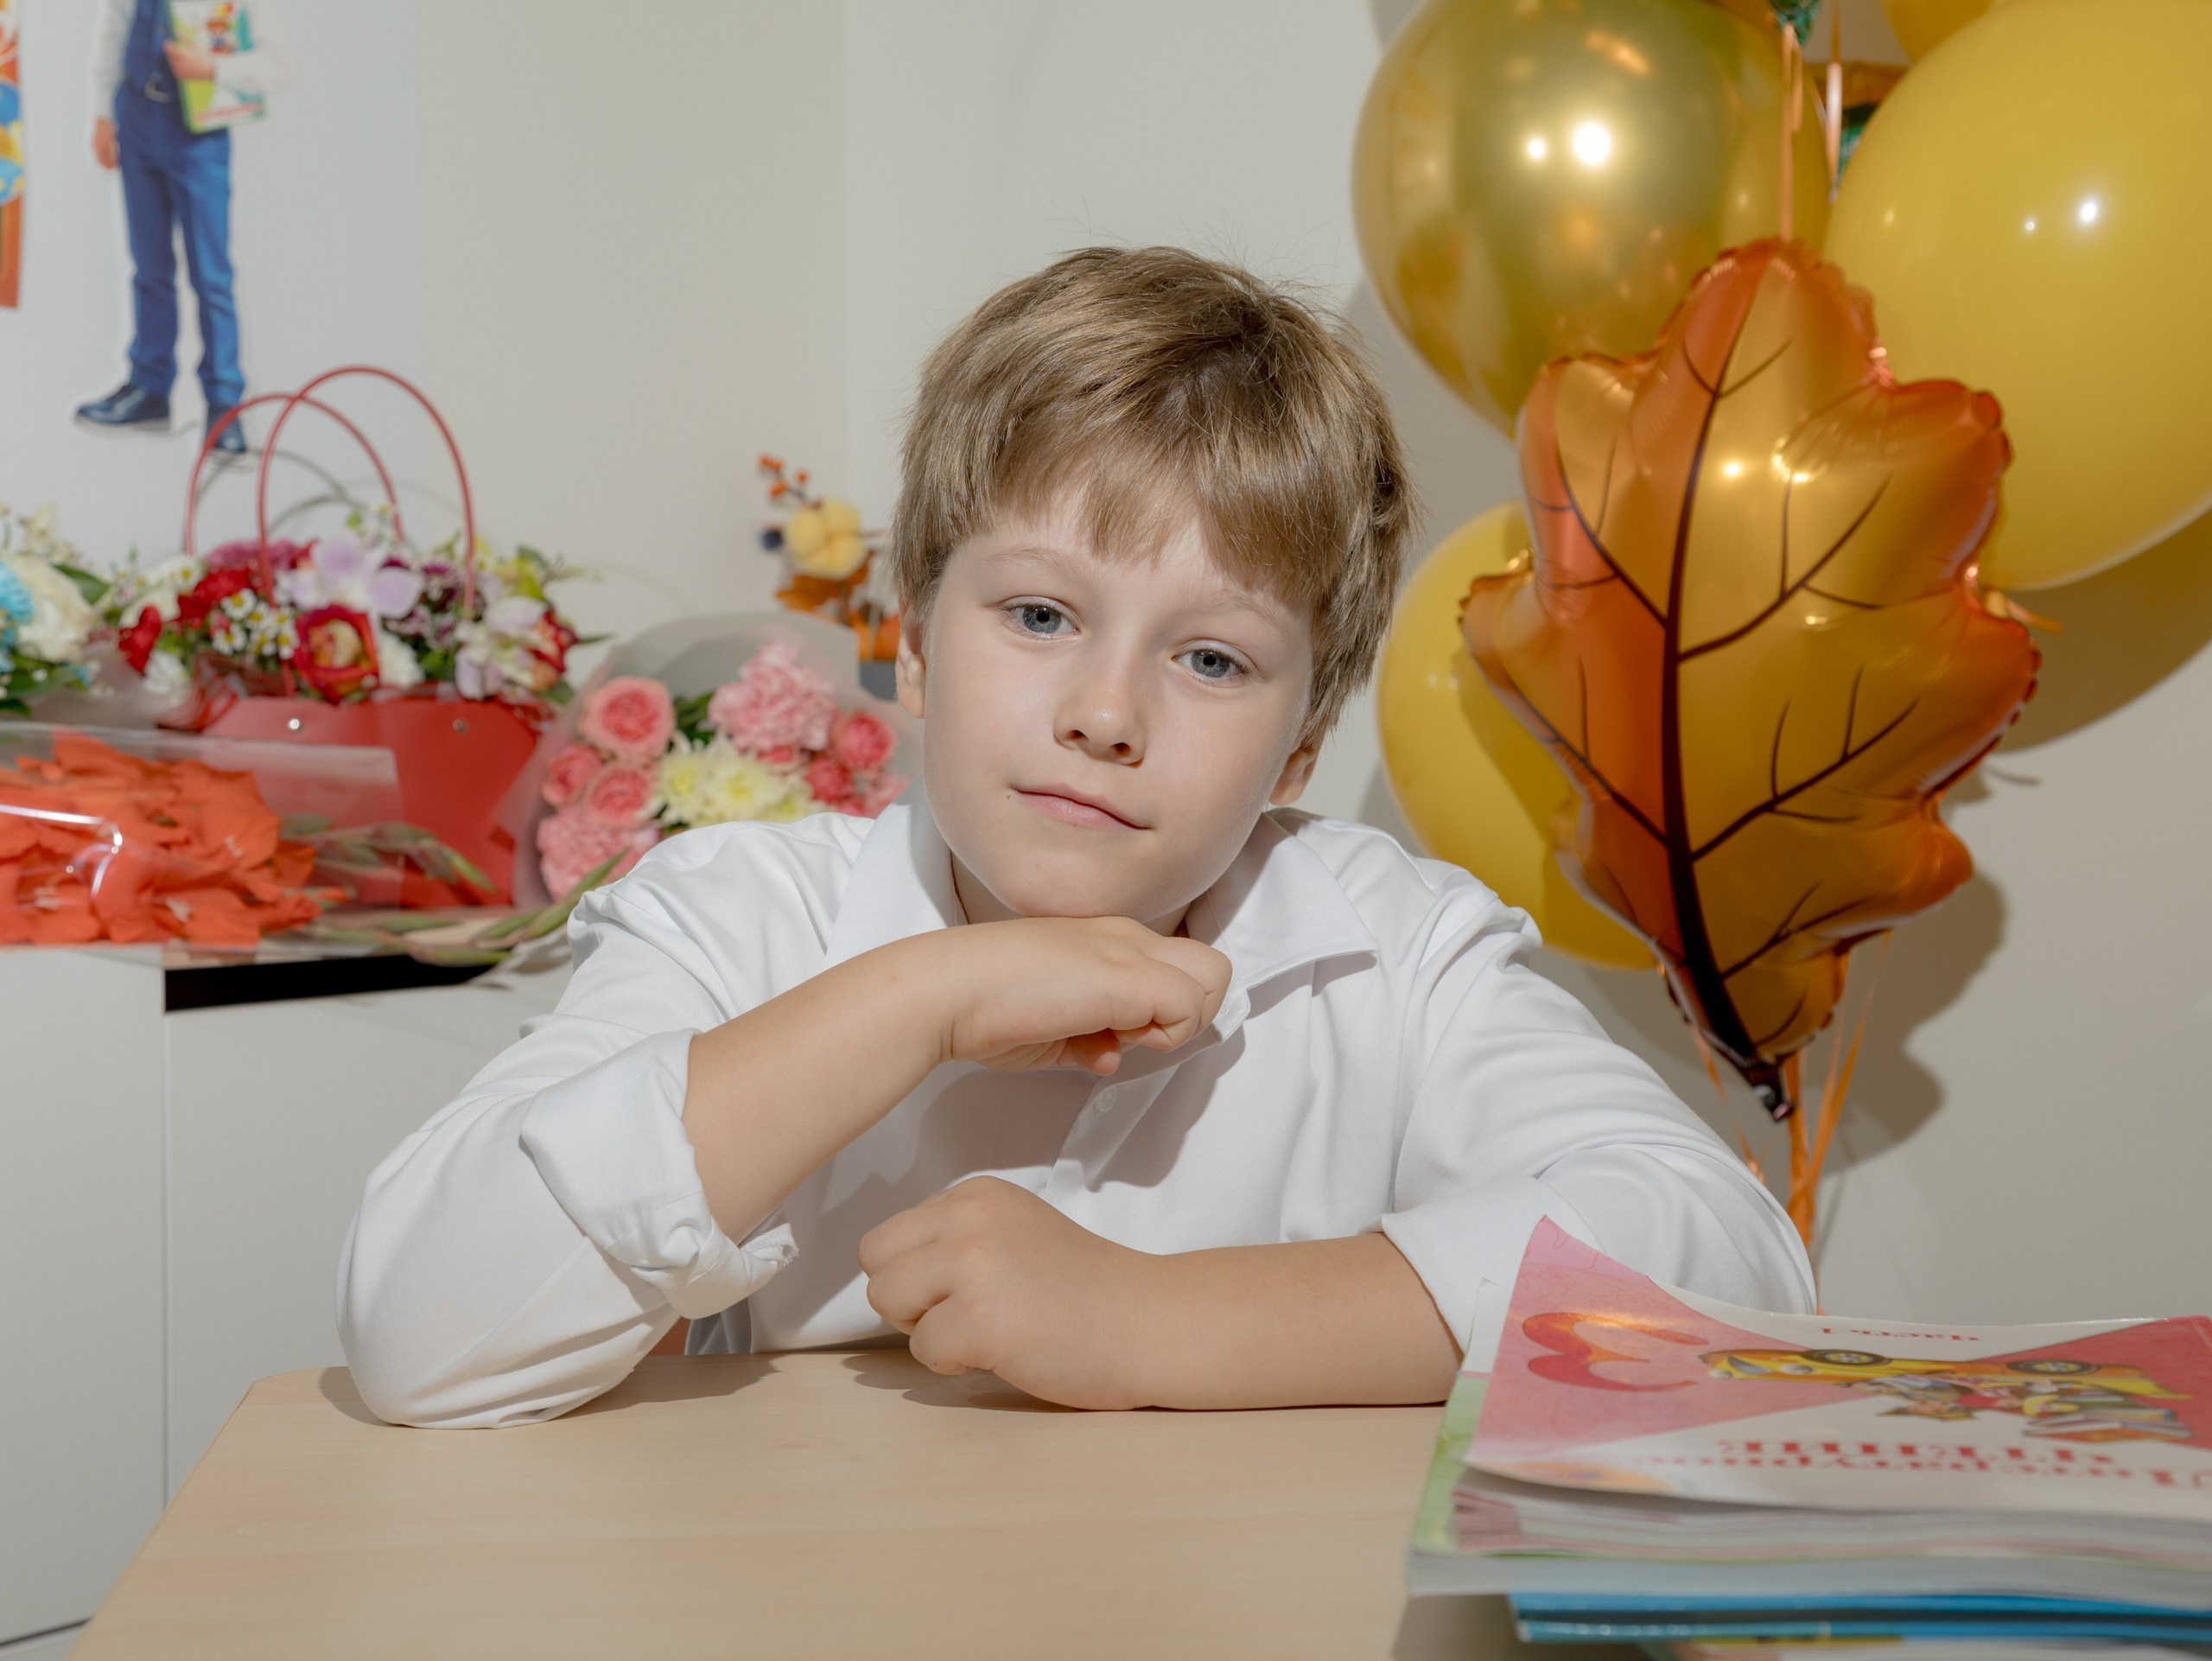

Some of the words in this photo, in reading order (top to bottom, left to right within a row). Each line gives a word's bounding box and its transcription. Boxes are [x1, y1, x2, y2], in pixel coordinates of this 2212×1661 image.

[1821, 1327, 1839, 1335] 1
[1522, 1312, 1709, 1392] 3
[1718, 1440, 2113, 1465] ЧТЕНИЕ
[1632, 1455, 2212, 1487] Литературное
